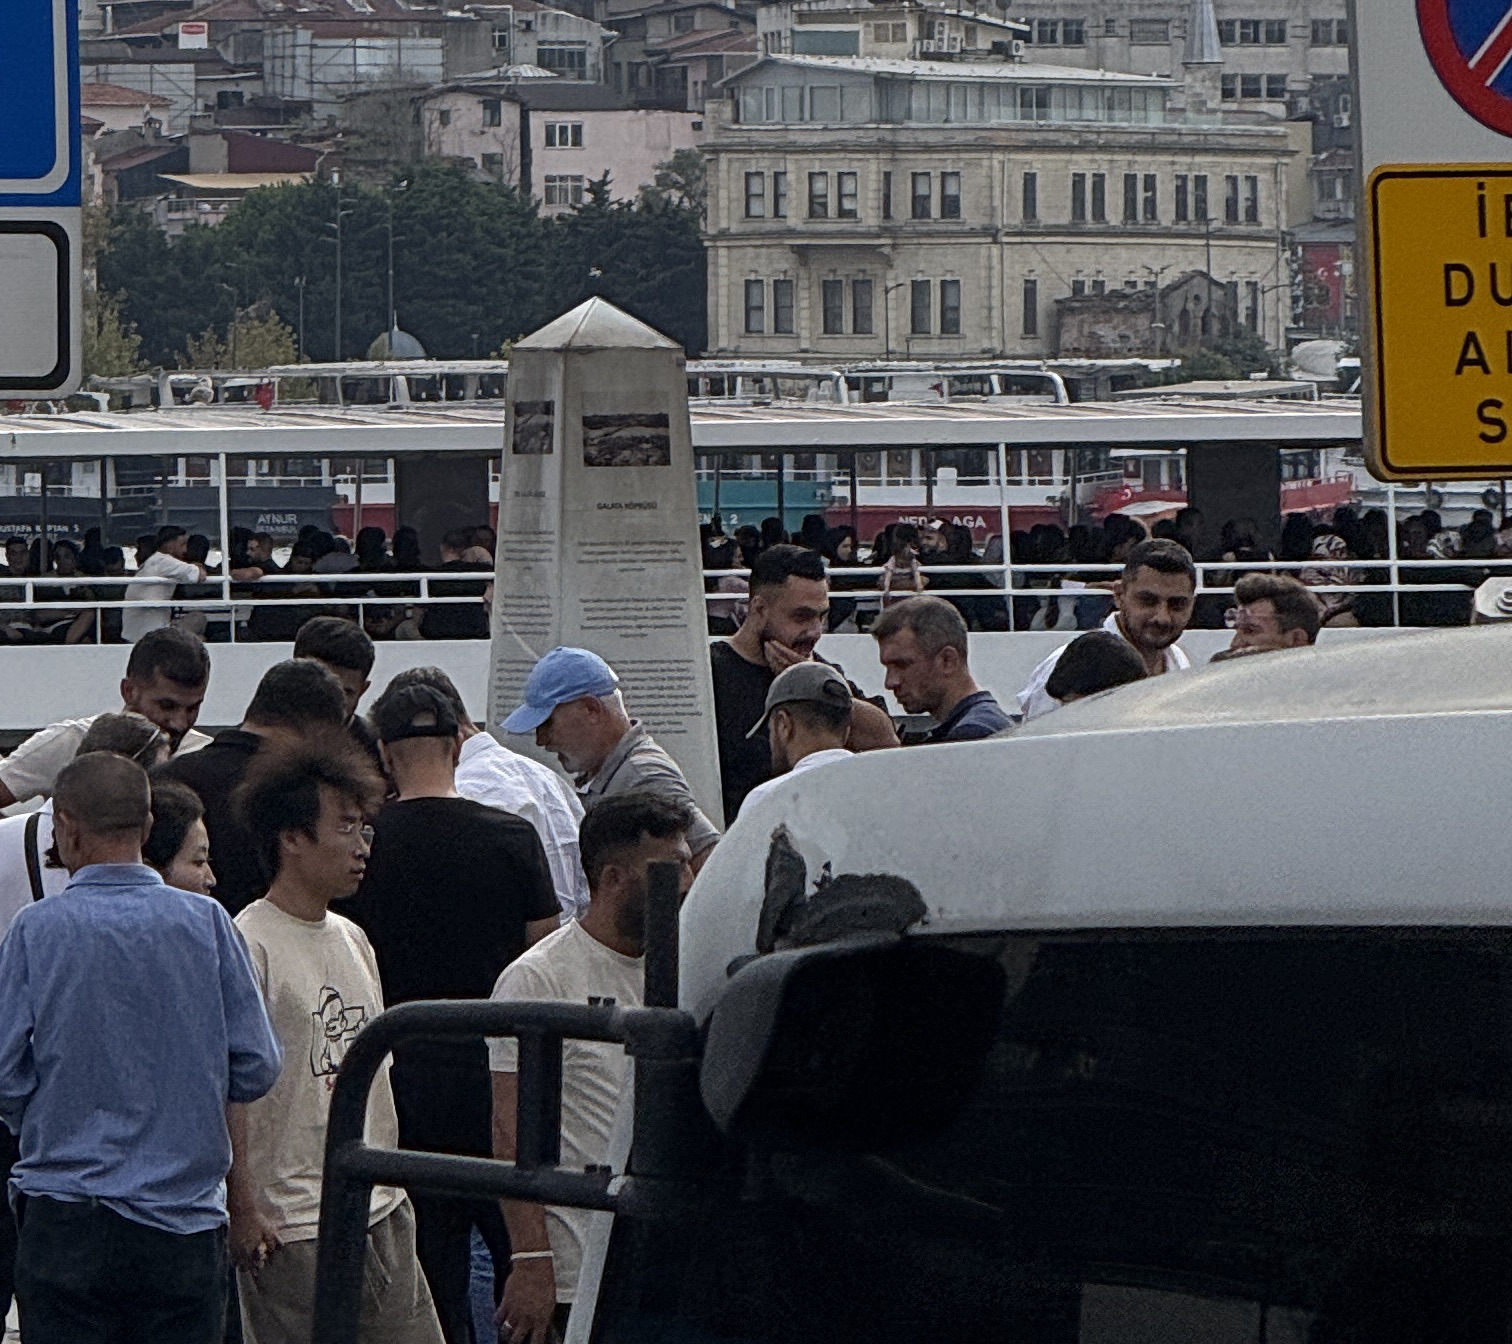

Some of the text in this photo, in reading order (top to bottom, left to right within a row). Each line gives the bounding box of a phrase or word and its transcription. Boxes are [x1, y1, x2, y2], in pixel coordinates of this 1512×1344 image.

[1455, 331, 1512, 375] A
[257, 514, 298, 525] AYNUR
[730, 514, 738, 524] 2
[36, 524, 69, 533] KPTAN
